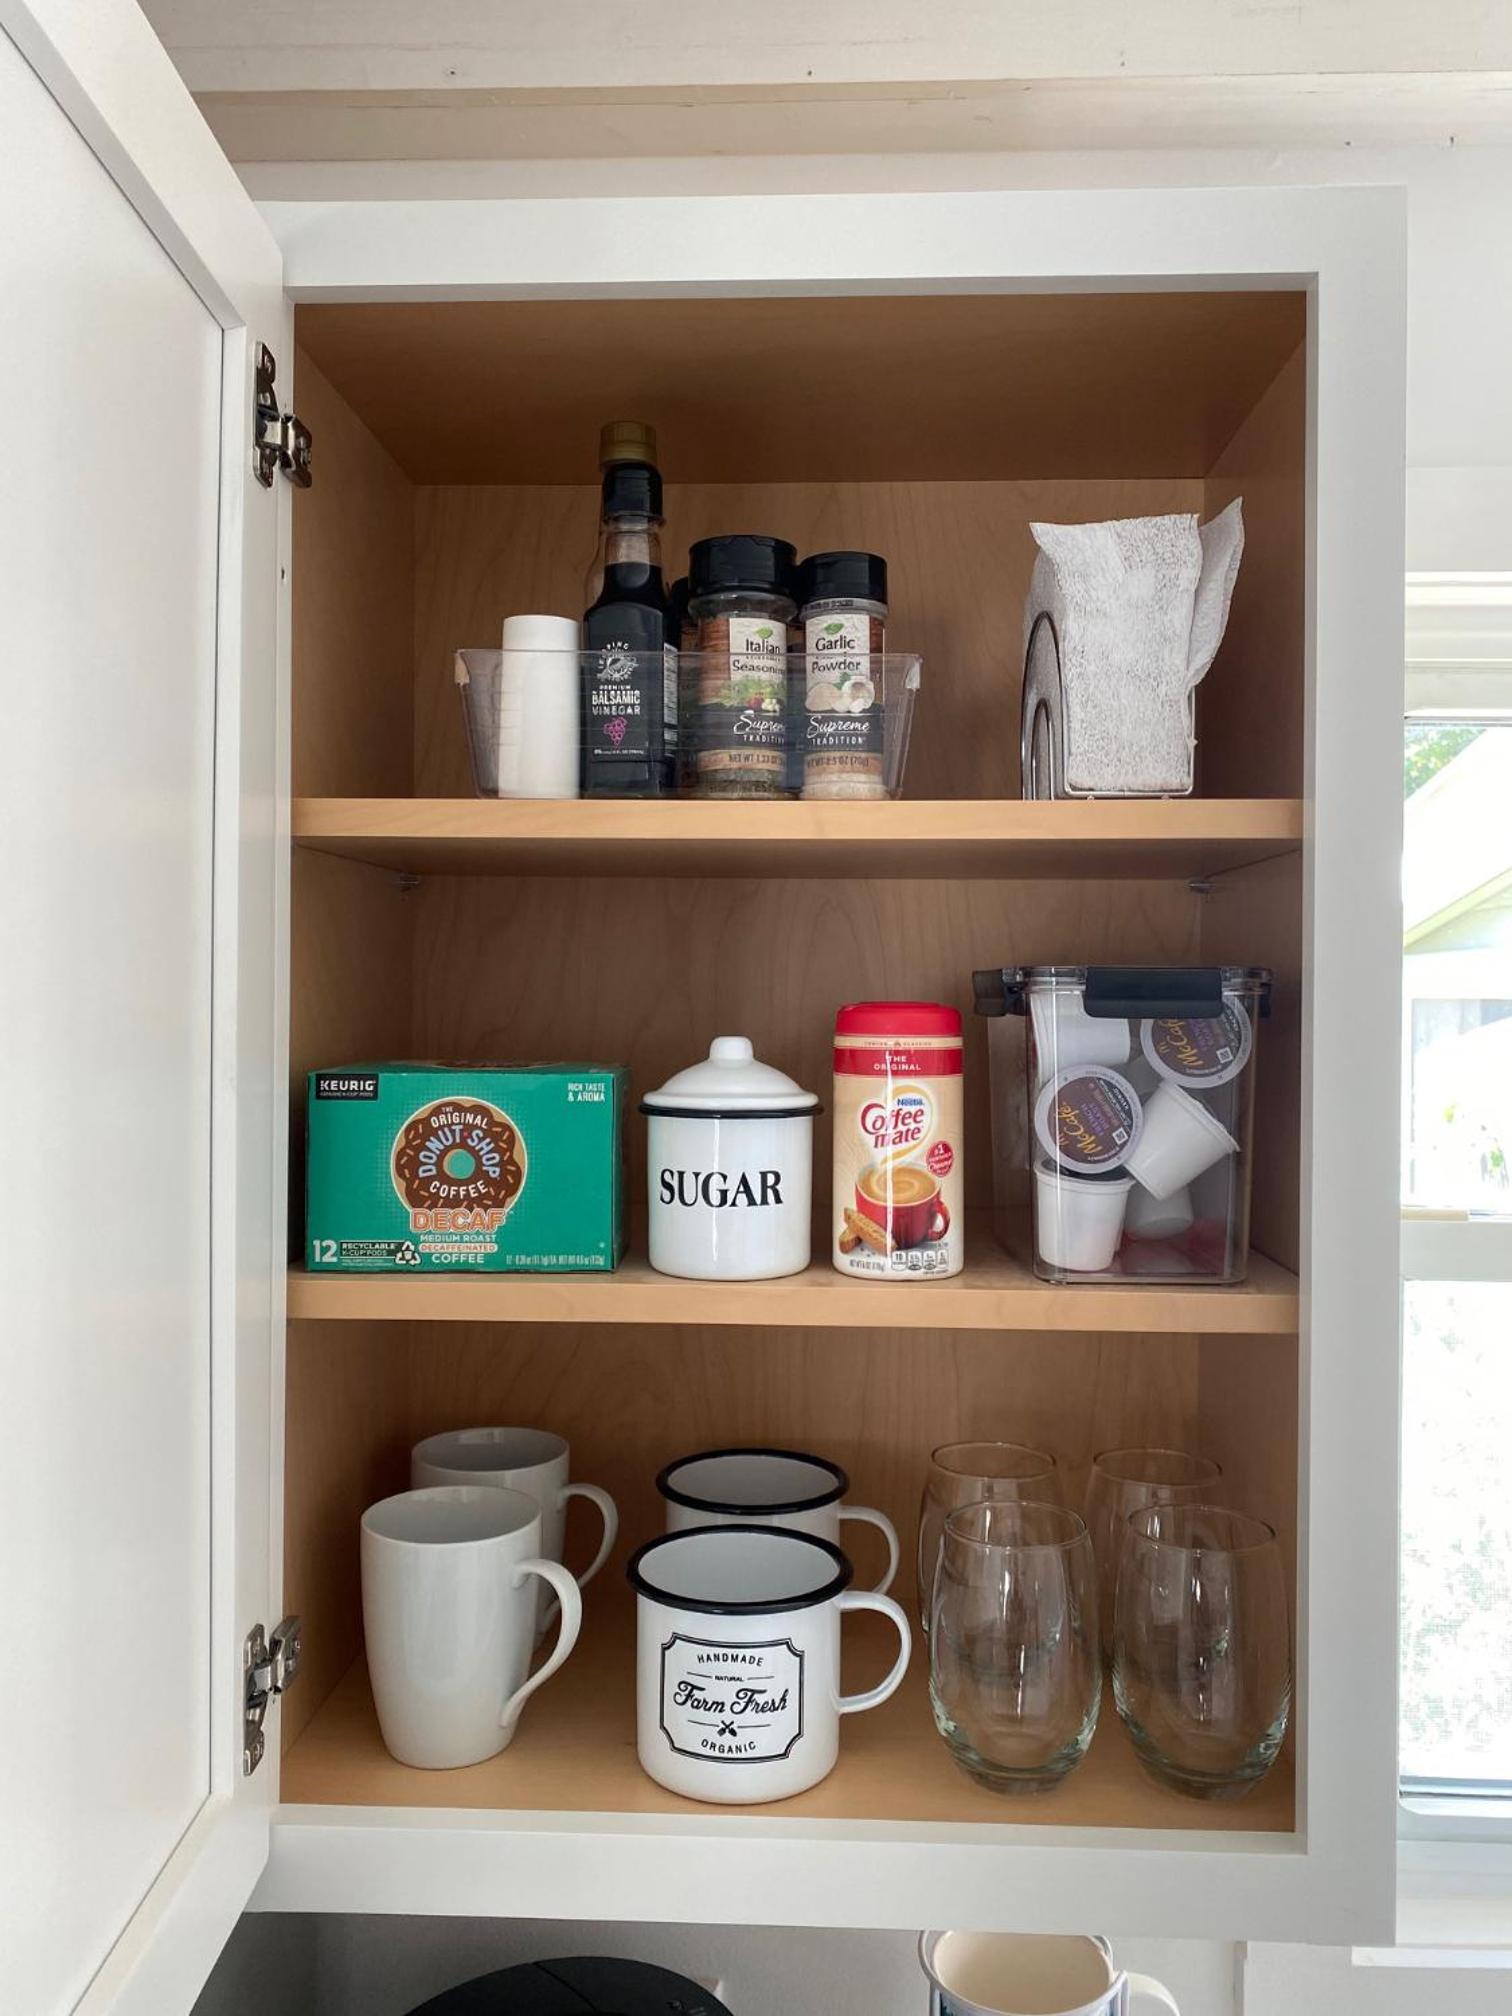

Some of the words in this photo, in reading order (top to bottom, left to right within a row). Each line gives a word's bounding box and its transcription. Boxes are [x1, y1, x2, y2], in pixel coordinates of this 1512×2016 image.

[745, 638, 781, 656] Italian
[815, 634, 856, 651] Garlic
[811, 656, 862, 674] Powder
[592, 690, 641, 705] BALSAMIC
[592, 705, 641, 715] VINEGAR
[806, 715, 871, 738] Supreme
[812, 735, 864, 745] TRADITION
[887, 1055, 907, 1063] THE
[320, 1080, 376, 1091] KEURIG
[577, 1091, 606, 1102] AROMA
[430, 1112, 489, 1130] ORIGINAL
[861, 1103, 925, 1136] Coffee
[873, 1126, 922, 1149] mate
[418, 1124, 464, 1178] DONUT
[466, 1128, 501, 1179] SHOP
[429, 1180, 489, 1199] COFFEE
[659, 1168, 784, 1208] SUGAR
[411, 1208, 506, 1232] DECAF
[341, 1242, 396, 1250] RECYCLABLE
[420, 1234, 462, 1242] MEDIUM
[463, 1234, 497, 1242] ROAST
[312, 1239, 338, 1263] 12
[366, 1249, 388, 1257] PODS
[420, 1243, 497, 1252] DECAFFEINATED
[431, 1253, 485, 1264] COFFEE
[697, 1653, 765, 1668] HANDMADE
[673, 1680, 726, 1714] Farm
[730, 1688, 790, 1715] Fresh
[700, 1738, 757, 1755] ORGANIC
